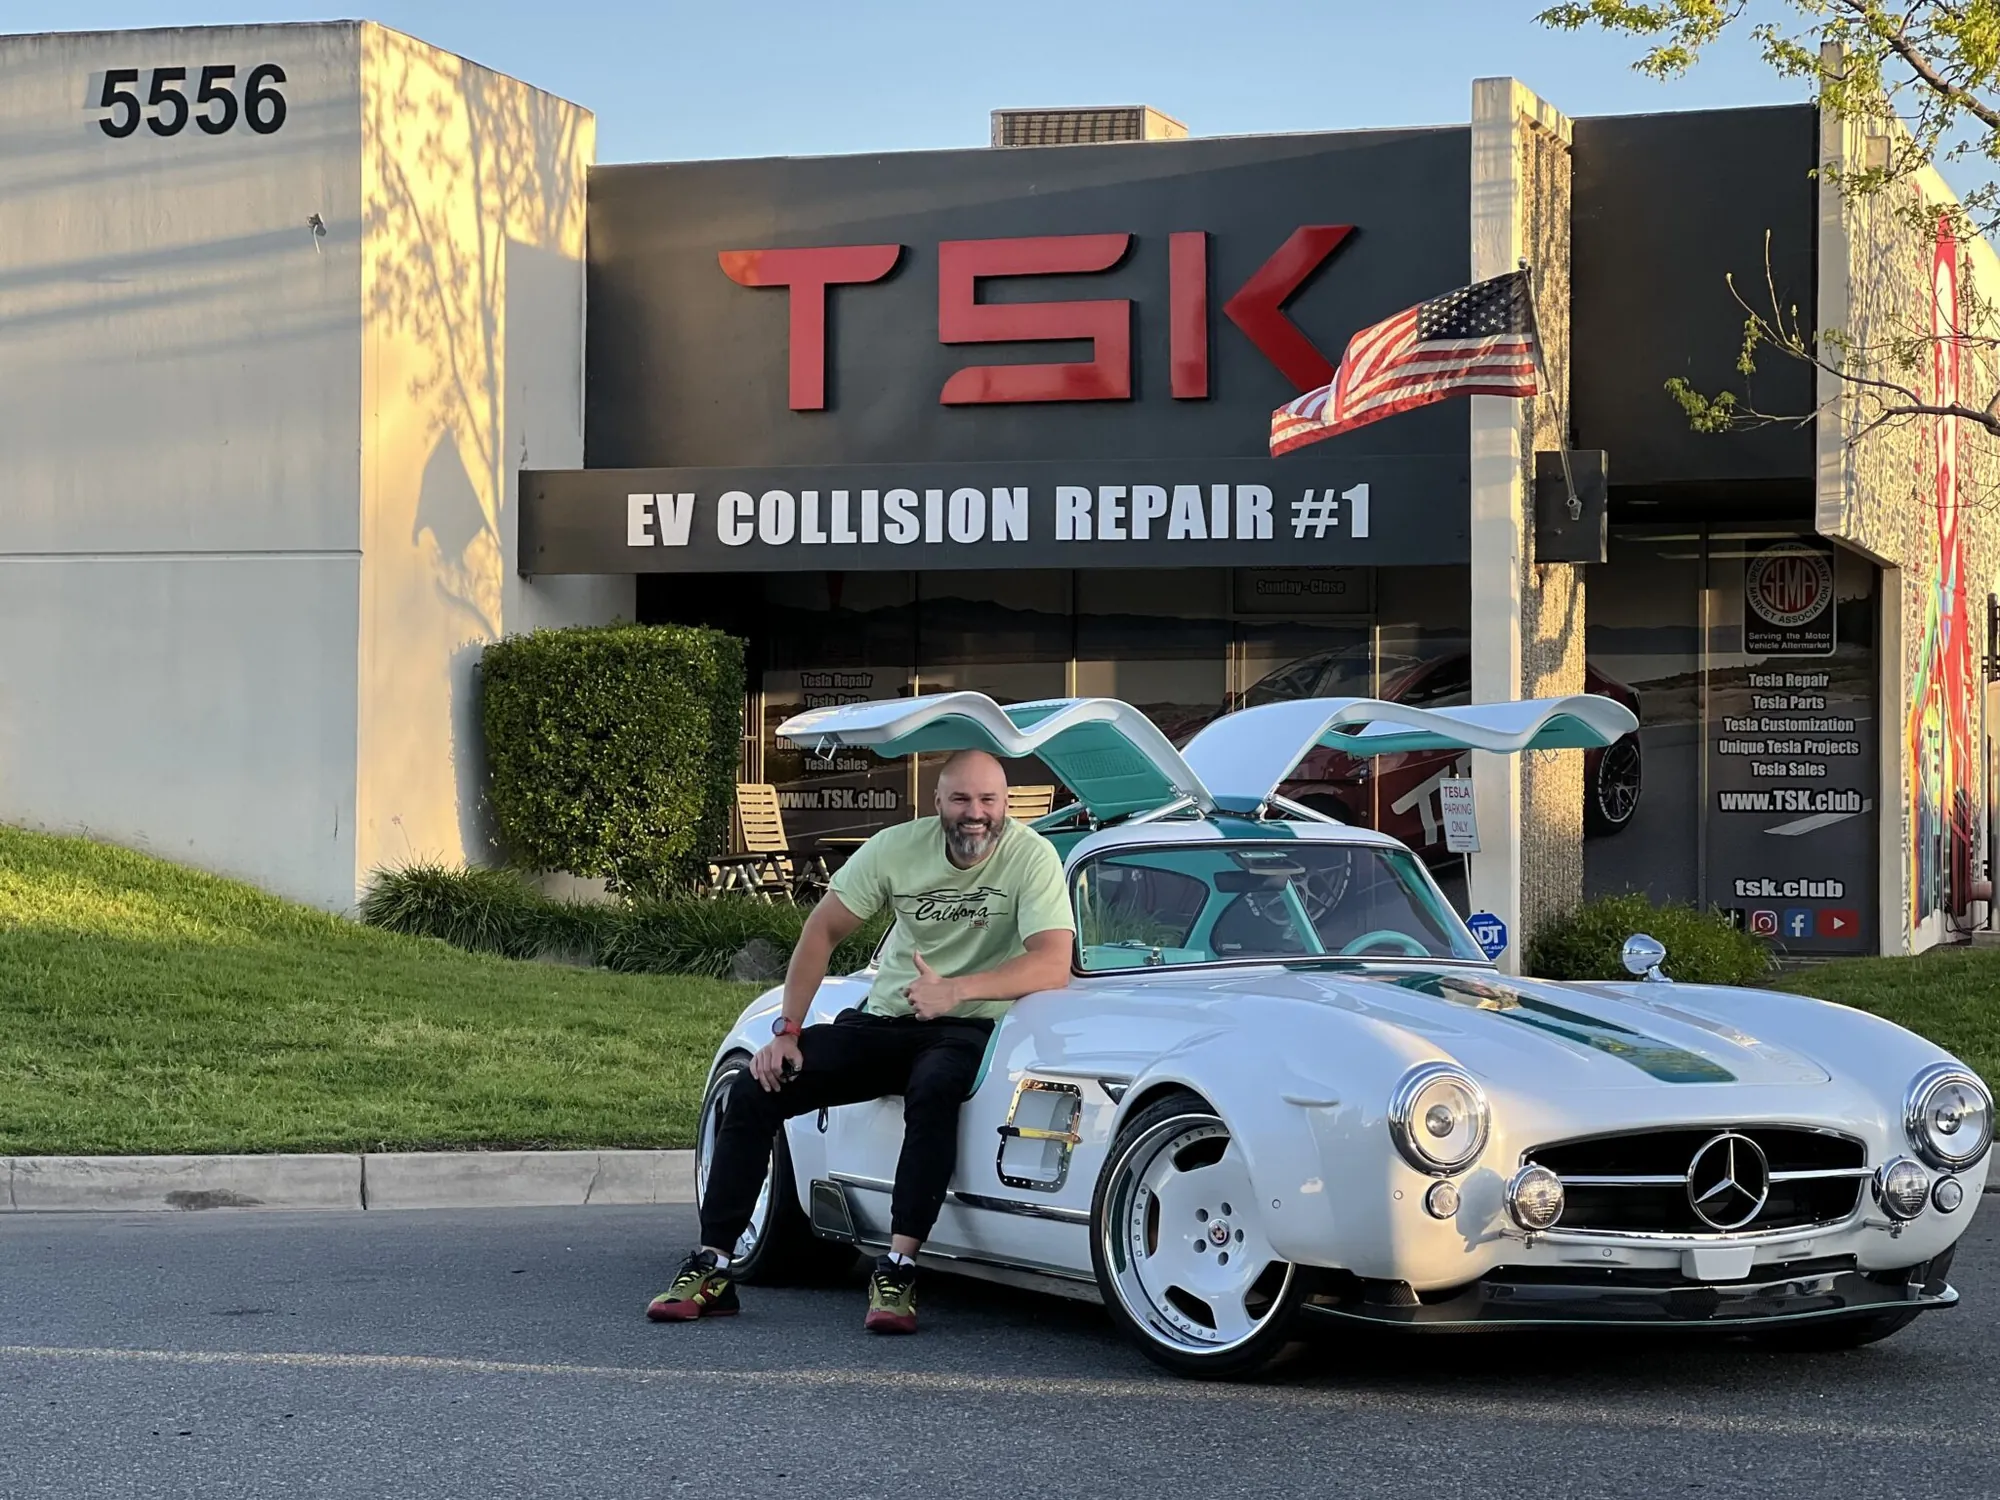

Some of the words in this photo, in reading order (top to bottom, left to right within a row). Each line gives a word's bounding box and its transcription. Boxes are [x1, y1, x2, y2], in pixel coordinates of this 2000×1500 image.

[98, 63, 287, 138] 5556
[718, 225, 1356, 410] TSK
[627, 493, 695, 546] EV
[717, 487, 1029, 545] COLLISION
[1055, 483, 1274, 541] REPAIR
[1291, 483, 1369, 539] #1
[1257, 580, 1302, 594] Sunday
[1310, 580, 1345, 593] Close
[1761, 558, 1817, 611] SEMA
[1750, 586, 1777, 620] MARKET
[1778, 585, 1830, 624] ASSOCIATION
[1748, 632, 1782, 642] Serving
[1786, 632, 1801, 640] the
[1805, 632, 1831, 640] Motor
[803, 674, 832, 687] Tesla
[834, 674, 872, 688] Repair
[1749, 673, 1783, 687] Tesla
[1786, 673, 1829, 688] Repair
[806, 695, 835, 707] Tesla
[1753, 696, 1787, 709] Tesla
[1790, 696, 1825, 709] Parts
[1724, 718, 1758, 731] Tesla
[1761, 718, 1854, 731] Customization
[1720, 740, 1765, 755] Unique
[1767, 740, 1801, 753] Tesla
[1804, 740, 1859, 755] Projects
[805, 758, 834, 770] Tesla
[837, 757, 868, 770] Sales
[1752, 762, 1786, 776] Tesla
[1789, 762, 1825, 776] Sales
[777, 789, 897, 809] www.TSK.club
[1443, 786, 1470, 798] TESLA
[1720, 790, 1860, 811] www.TSK.club
[1444, 803, 1472, 815] PARKING
[1452, 821, 1469, 833] ONLY
[1735, 879, 1843, 897] tsk.club
